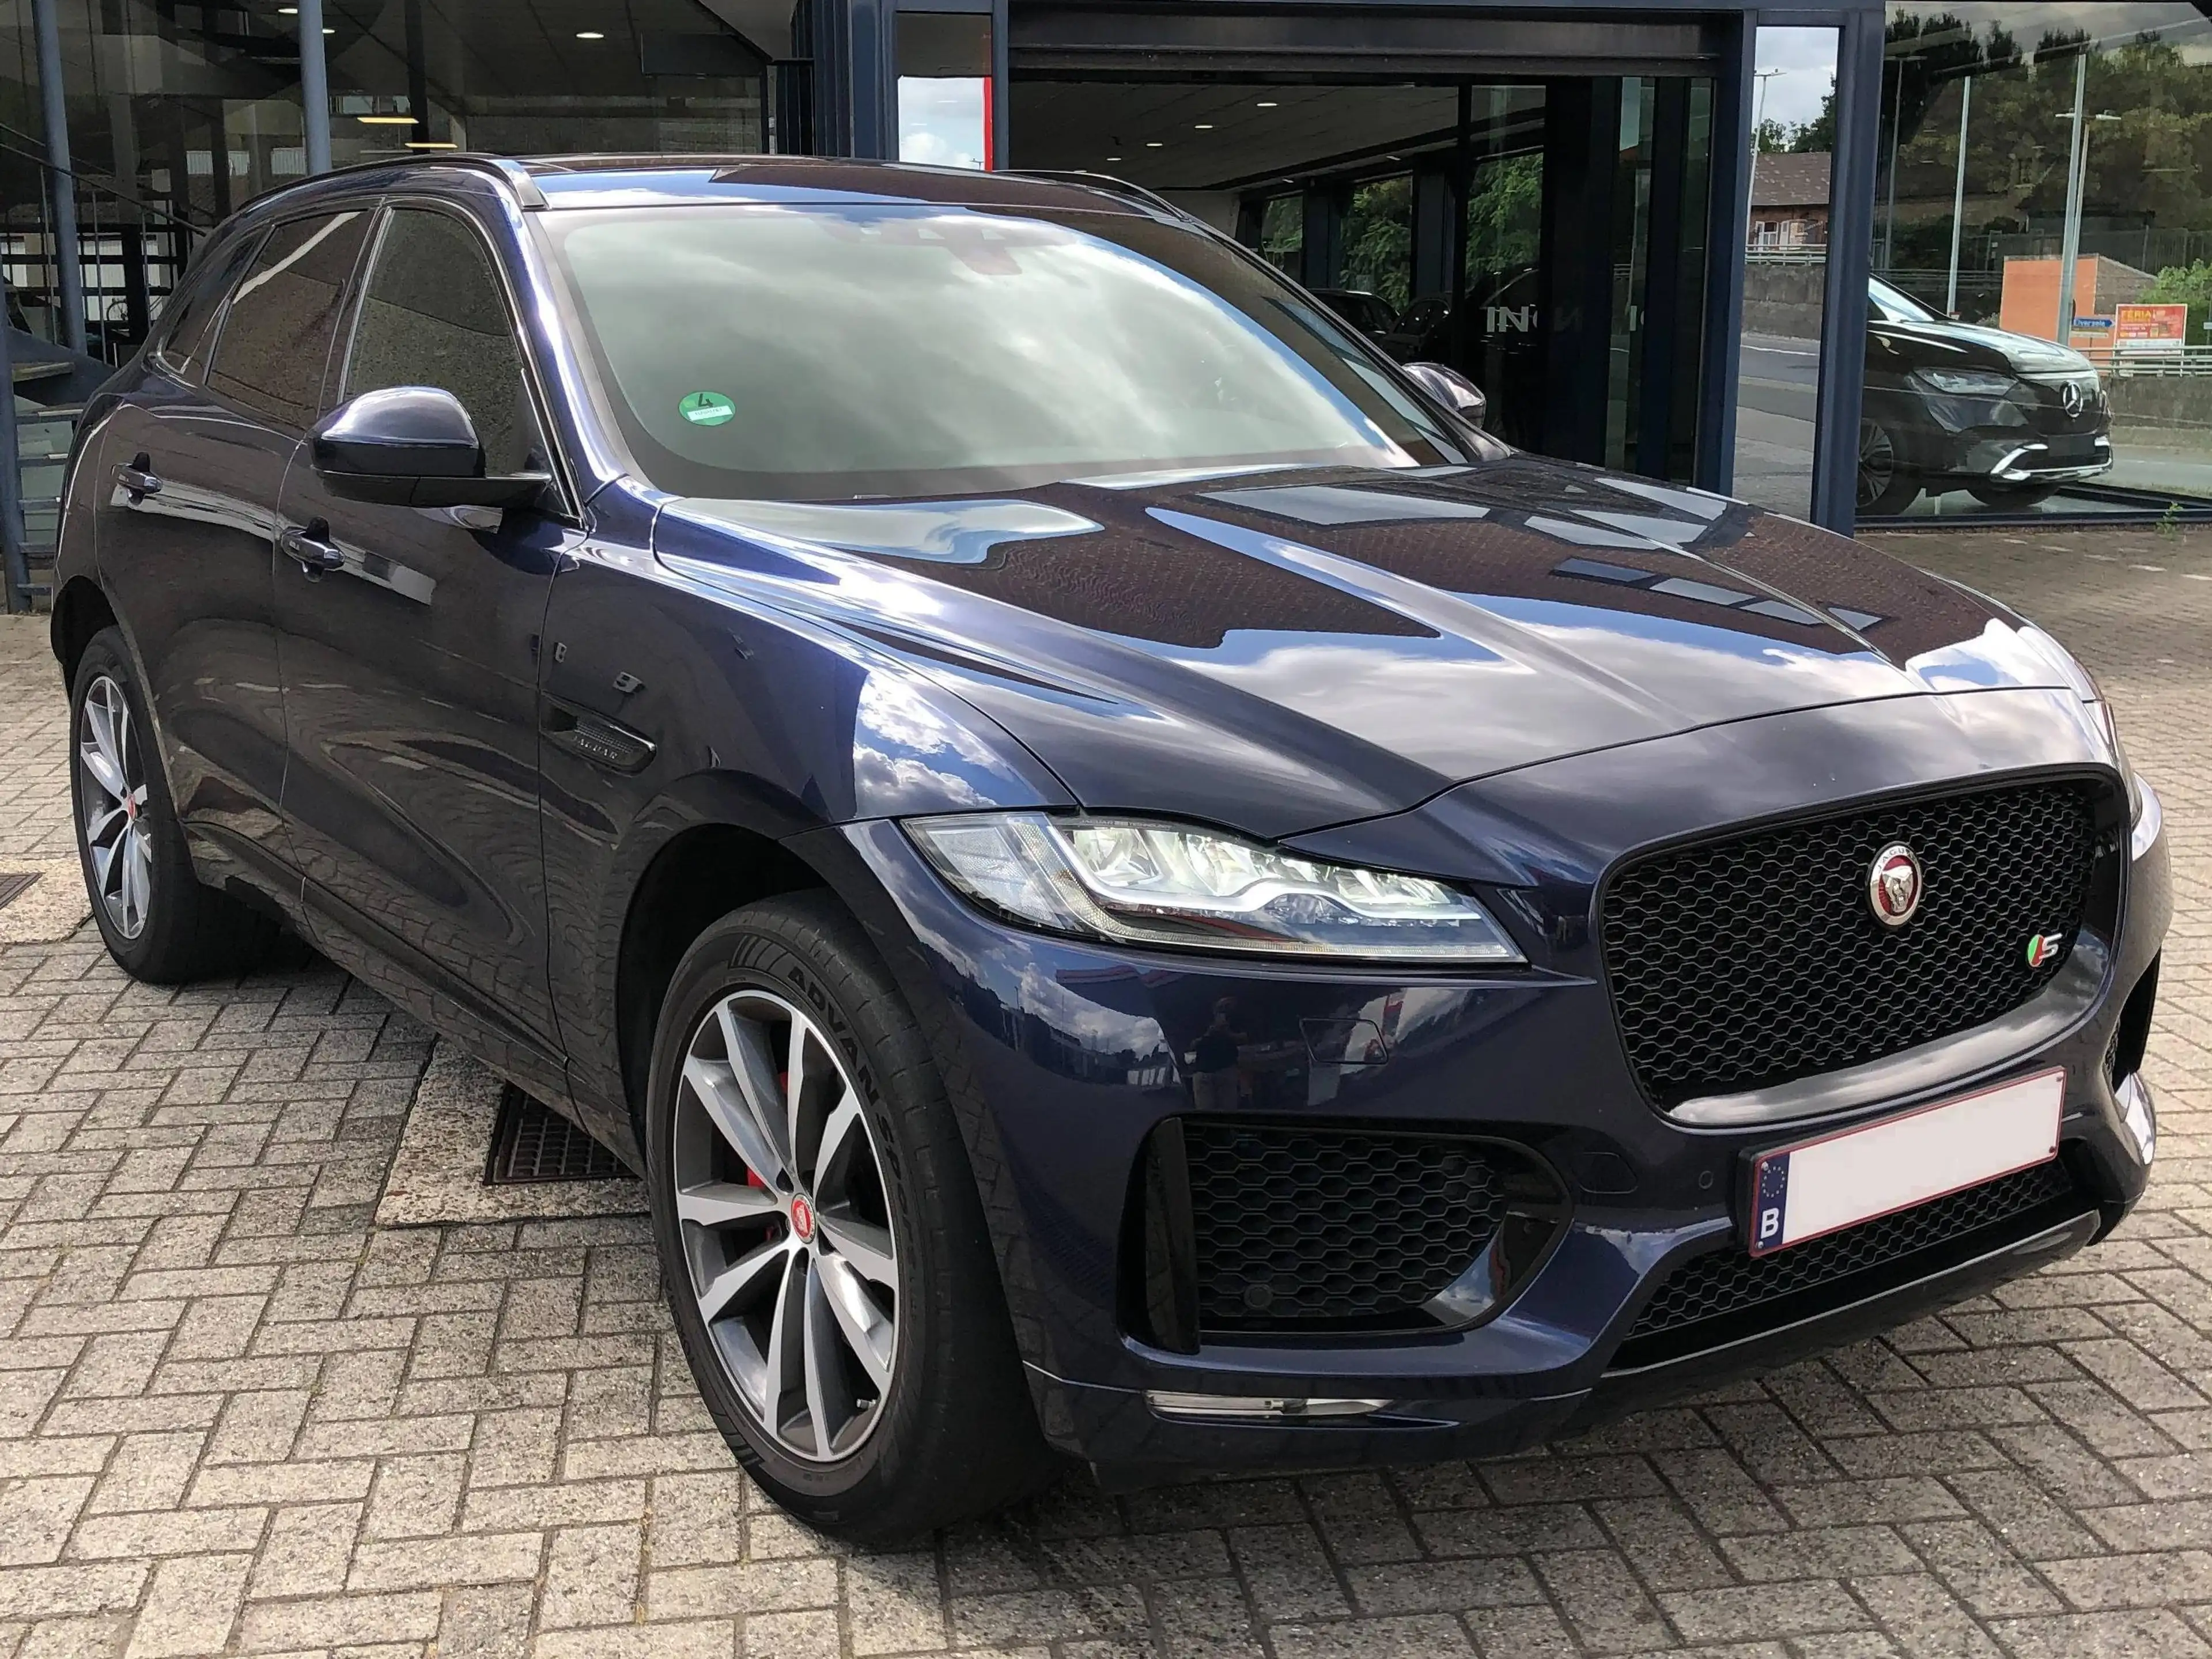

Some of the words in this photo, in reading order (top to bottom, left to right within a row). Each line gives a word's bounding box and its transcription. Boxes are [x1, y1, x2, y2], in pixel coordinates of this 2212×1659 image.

[1487, 306, 1537, 332] IN
[698, 393, 713, 407] 4
[2039, 933, 2062, 960] S
[787, 966, 880, 1105] ADVAN
[1760, 1207, 1779, 1239] B
